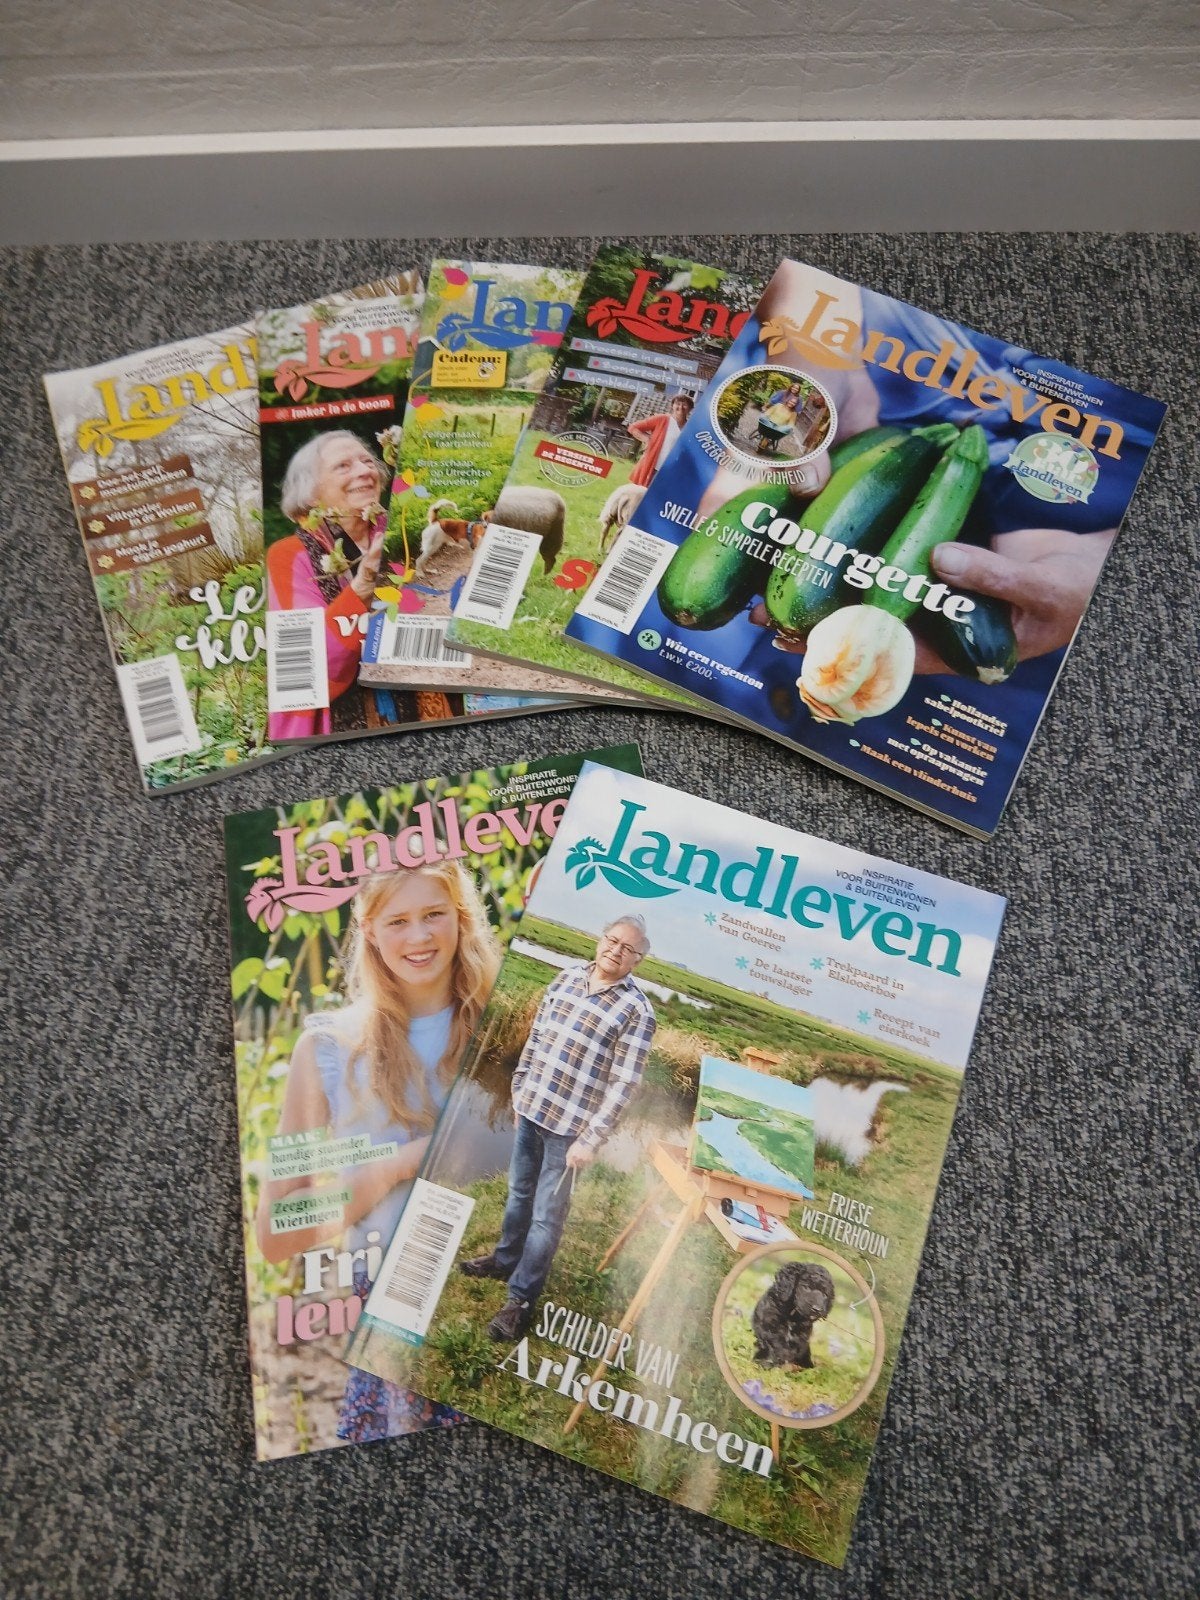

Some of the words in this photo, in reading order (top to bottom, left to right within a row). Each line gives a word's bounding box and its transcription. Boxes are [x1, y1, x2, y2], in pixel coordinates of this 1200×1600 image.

[439, 353, 501, 364] Cadeau:
[1012, 366, 1037, 381] VOOR
[1038, 377, 1104, 407] BUITENWONEN
[1037, 368, 1084, 391] INSPIRATIE
[292, 406, 326, 419] Imker
[329, 404, 341, 415] in
[343, 401, 356, 413] de
[359, 398, 391, 410] boom
[1028, 381, 1089, 409] BUITENLEVEN
[430, 471, 443, 479] op
[446, 469, 492, 477] Utrechtse
[441, 460, 474, 469] schaap
[760, 468, 806, 485] VRIJHEID
[430, 478, 479, 488] Heuvelrug
[659, 500, 707, 533] SNELLE
[705, 520, 718, 537] &
[718, 526, 772, 562] SIMPELE
[770, 550, 834, 590] RECEPTEN
[740, 502, 976, 623] Courgette
[659, 649, 683, 666] t.w.v.
[665, 637, 688, 655] Win
[687, 650, 711, 665] een
[710, 660, 764, 690] regenton
[886, 737, 911, 753] met
[860, 744, 892, 765] Maak
[891, 759, 913, 774] een
[912, 769, 978, 803] vlinderhuis
[921, 744, 939, 757] Op
[938, 750, 988, 778] vakantie
[509, 769, 558, 785] INSPIRATIE
[488, 785, 514, 798] VOOR
[501, 796, 508, 804] &
[510, 785, 571, 803] BUITENLEVEN
[607, 799, 962, 977] Landleven
[835, 869, 863, 883] VOOR
[865, 878, 937, 908] BUITENWONEN
[862, 868, 914, 891] INSPIRATIE
[845, 882, 852, 891] &
[854, 885, 920, 913] BUITENLEVEN
[719, 924, 738, 937] van
[742, 931, 781, 952] Goeree
[721, 913, 786, 942] Zandwallen
[749, 968, 813, 996] touwslager
[754, 958, 769, 970] De
[772, 963, 813, 985] laatste
[826, 956, 889, 985] Trekpaard
[892, 979, 904, 991] in
[828, 969, 896, 999] Elslooërbos
[874, 1008, 915, 1030] Recept
[918, 1025, 941, 1039] van
[879, 1023, 931, 1047] eierkoek
[271, 1165, 297, 1178] voor
[274, 1208, 340, 1230] Wieringen
[828, 1191, 874, 1228] FRIESE
[801, 1205, 890, 1259] WETTERHOUN
[535, 1301, 632, 1371] SCHILDER
[635, 1339, 680, 1389] VAN
[495, 1337, 774, 1479] Arkemheen
